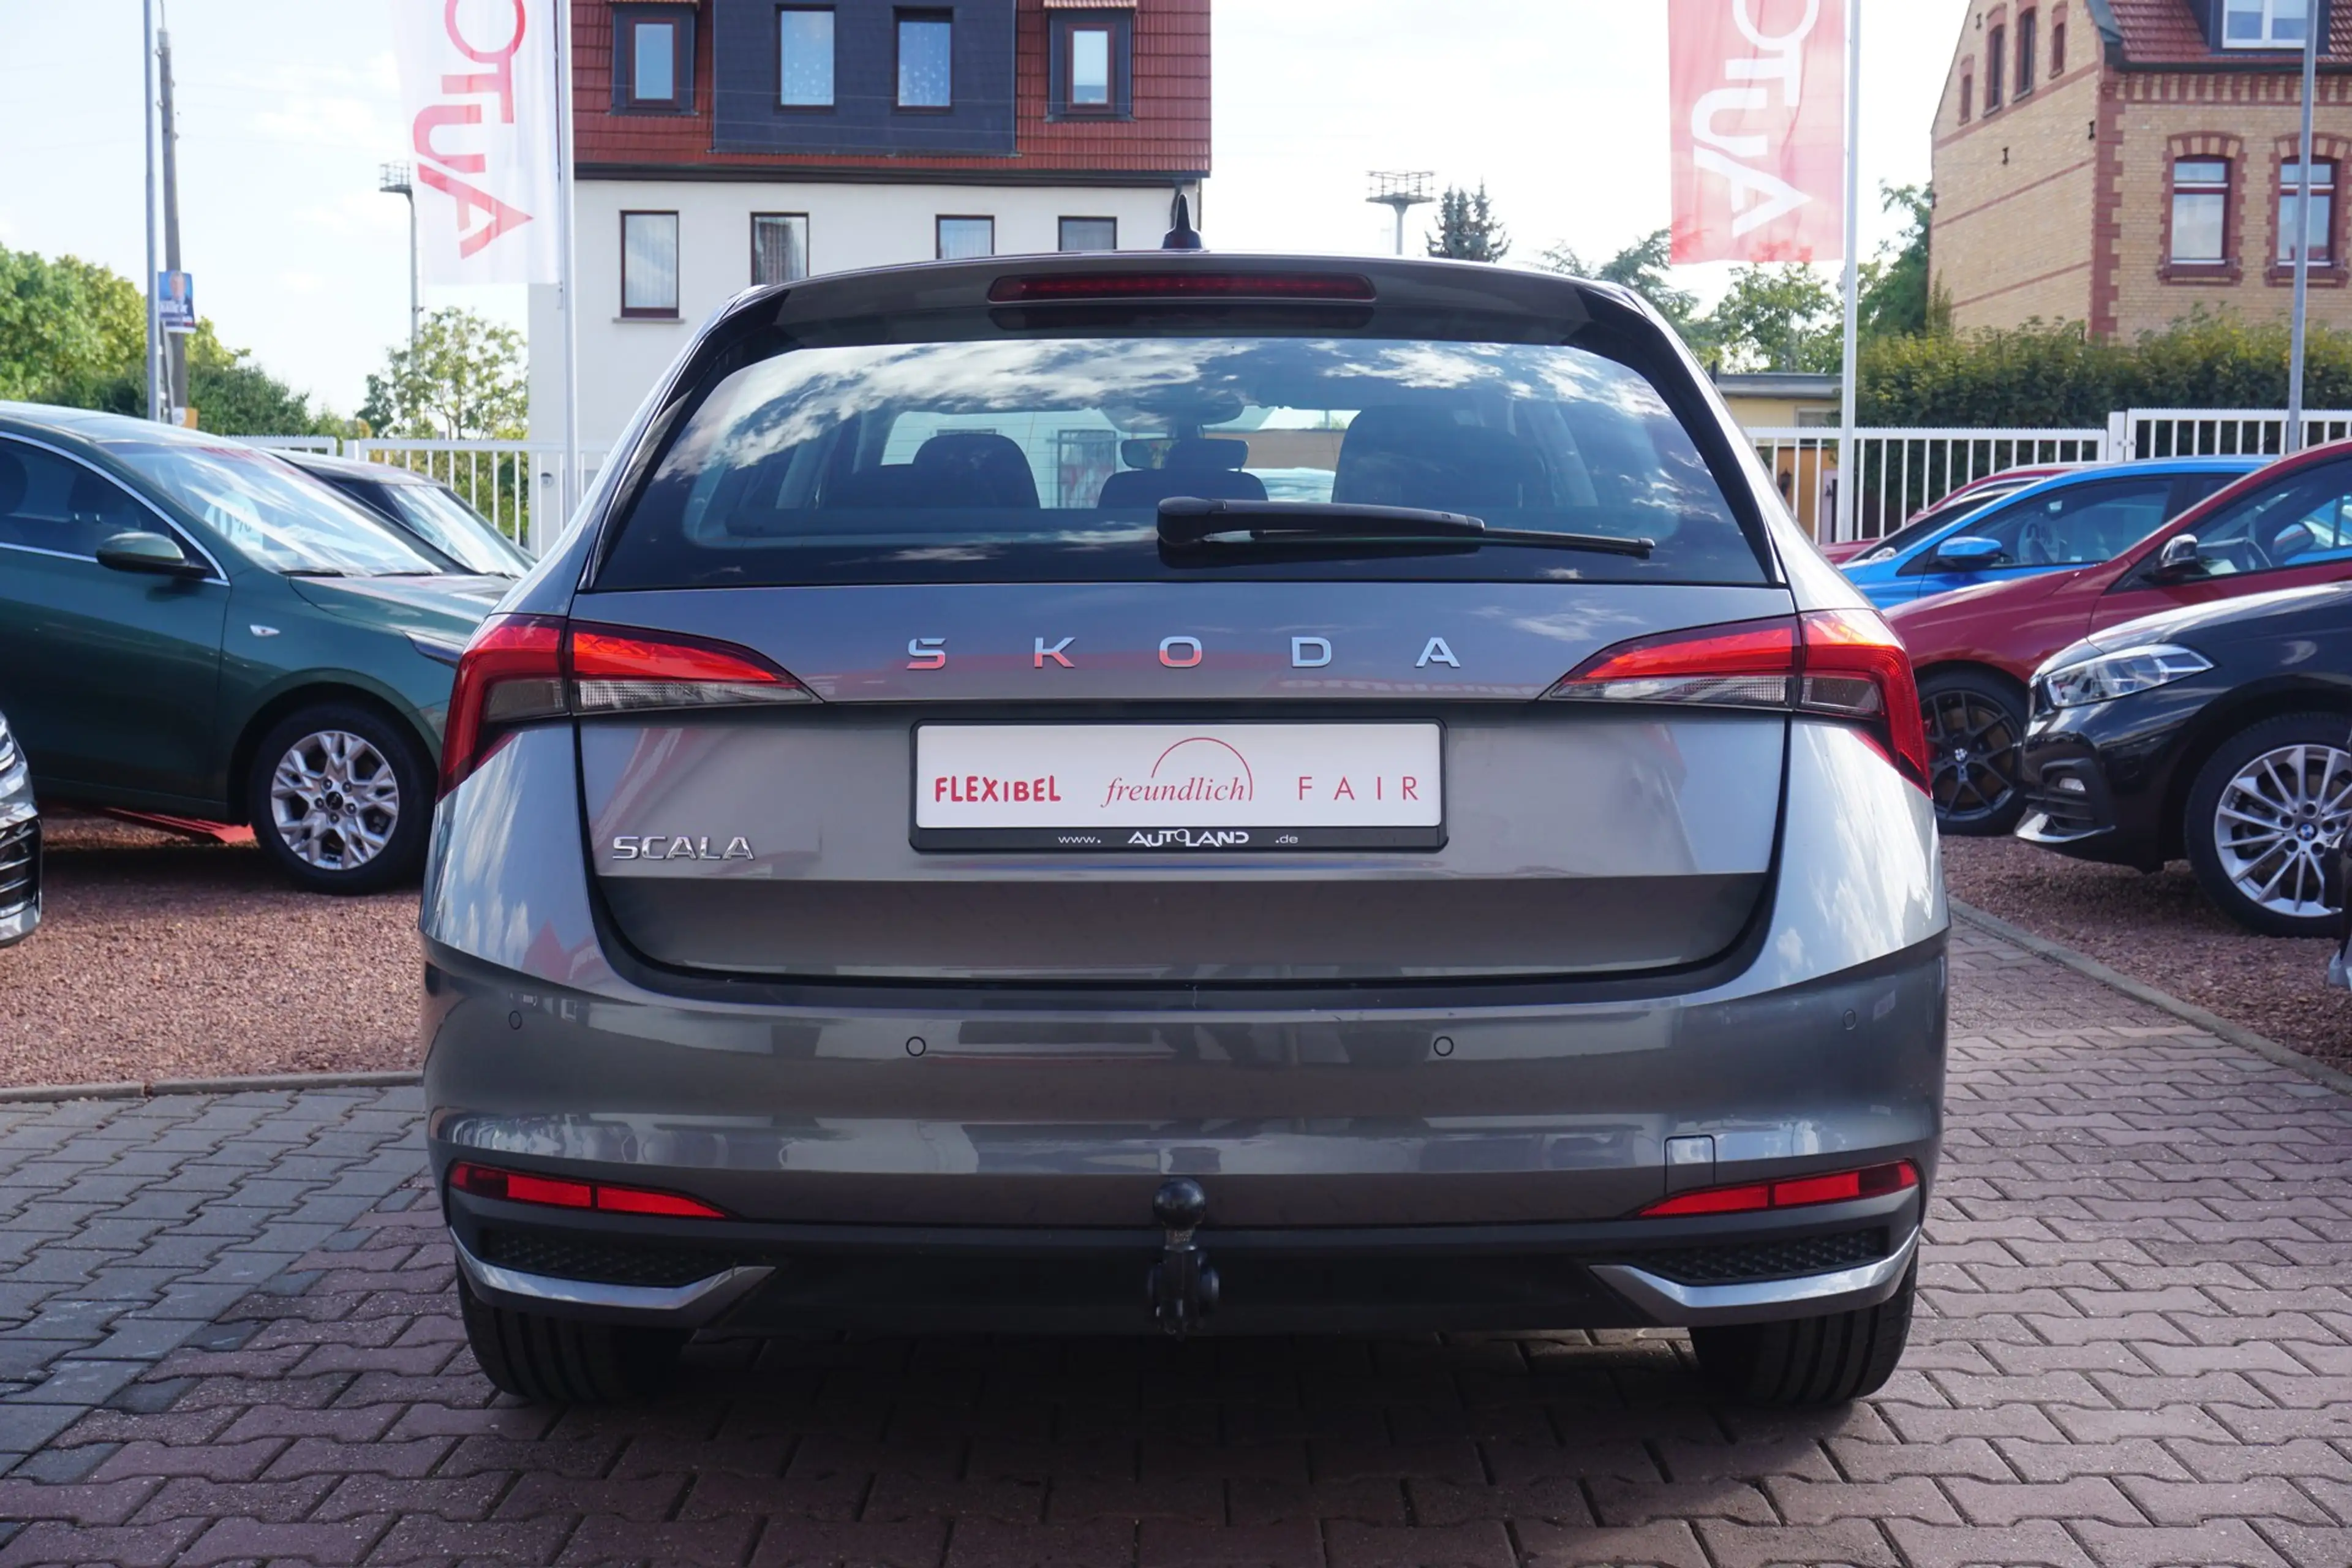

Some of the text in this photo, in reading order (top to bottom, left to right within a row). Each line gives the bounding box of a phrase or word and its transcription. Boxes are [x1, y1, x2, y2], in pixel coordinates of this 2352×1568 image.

[907, 636, 1461, 669] SKODA
[935, 775, 1419, 808] FLEXIBEL freundlich FAIR
[612, 836, 755, 861] SCALA
